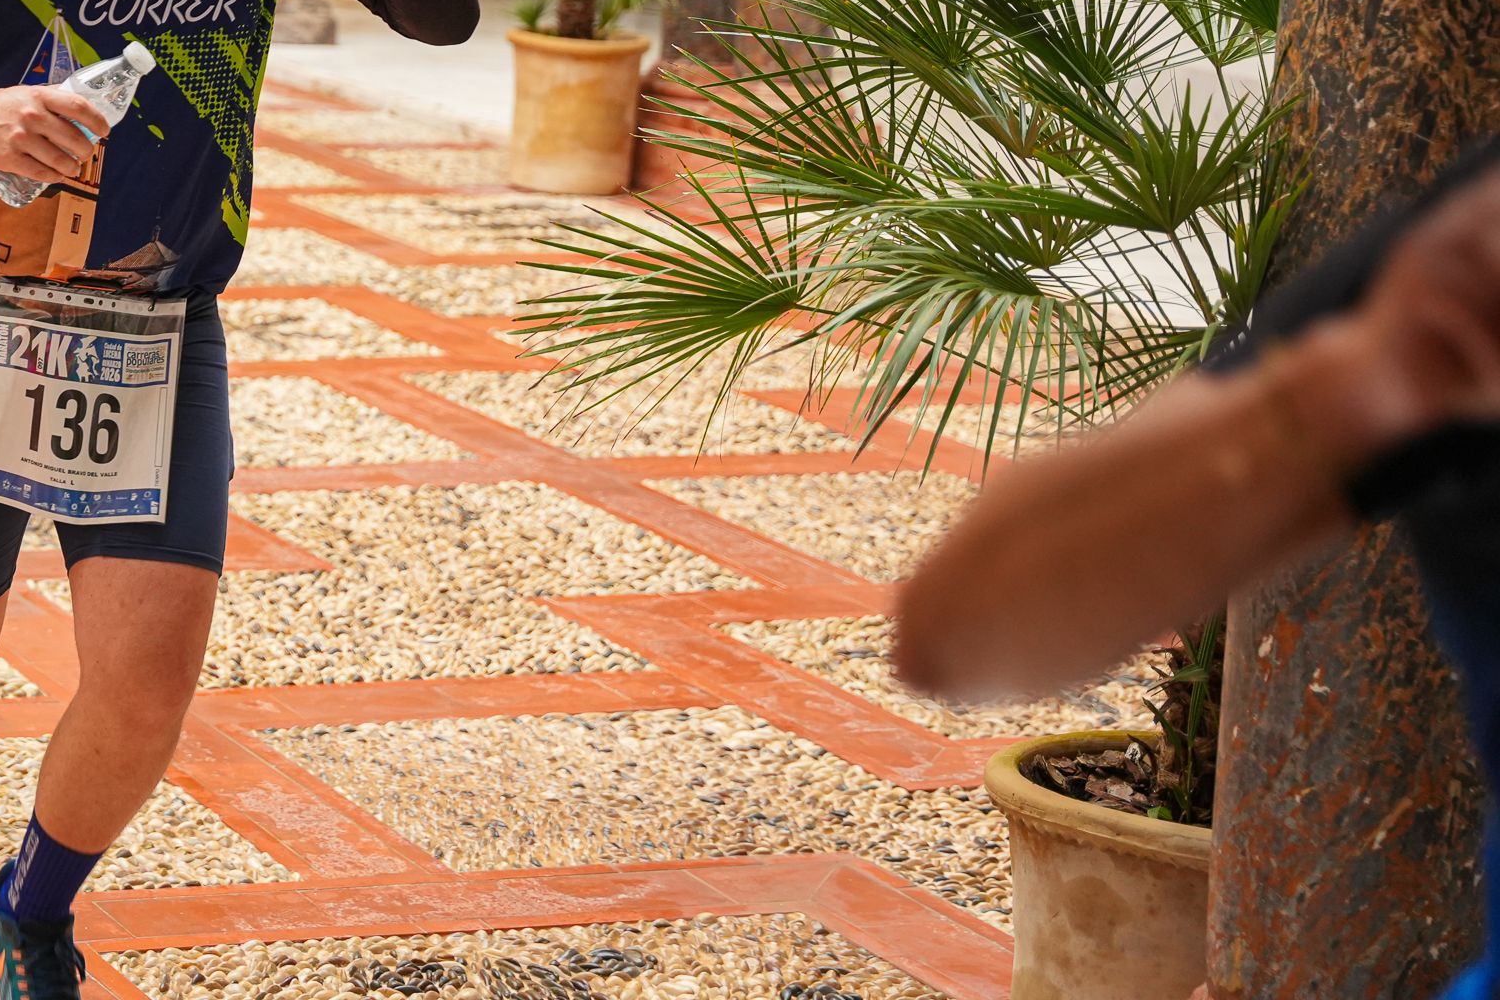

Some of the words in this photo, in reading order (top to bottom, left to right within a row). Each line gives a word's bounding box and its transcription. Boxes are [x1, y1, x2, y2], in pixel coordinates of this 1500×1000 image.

[10, 326, 73, 377] 21K
[126, 351, 160, 360] carreras
[126, 357, 165, 368] populares
[100, 367, 121, 382] 2026
[25, 384, 121, 464] 136
[20, 457, 43, 468] ANTONIO
[43, 464, 66, 474] MIGUEL
[49, 476, 67, 484] TALLA
